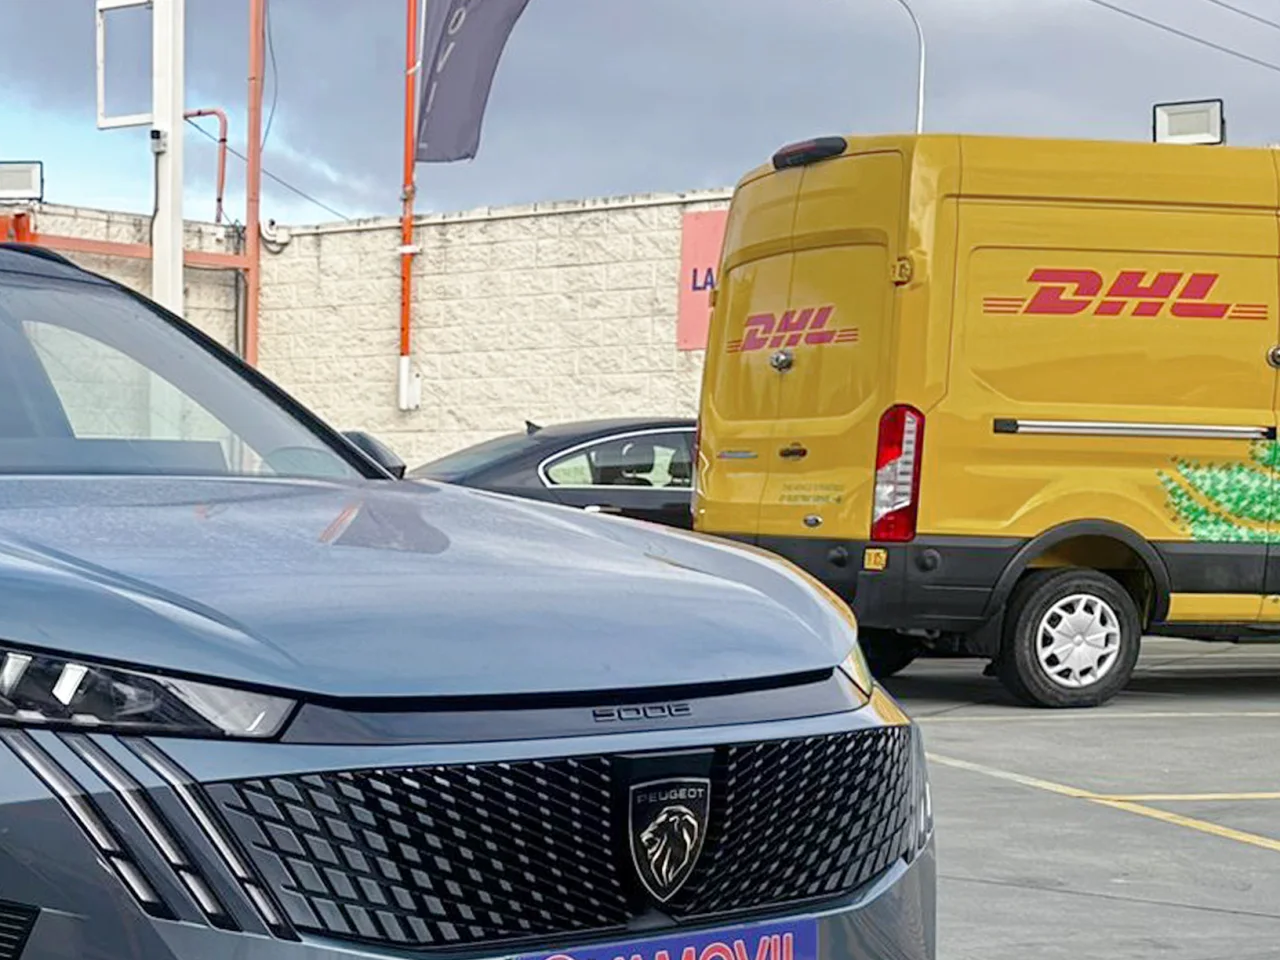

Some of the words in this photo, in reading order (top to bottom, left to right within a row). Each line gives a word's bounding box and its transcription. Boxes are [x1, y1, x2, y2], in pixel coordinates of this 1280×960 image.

[1022, 268, 1231, 318] DHL
[741, 305, 838, 352] DHL
[636, 788, 705, 804] PEUGEOT
